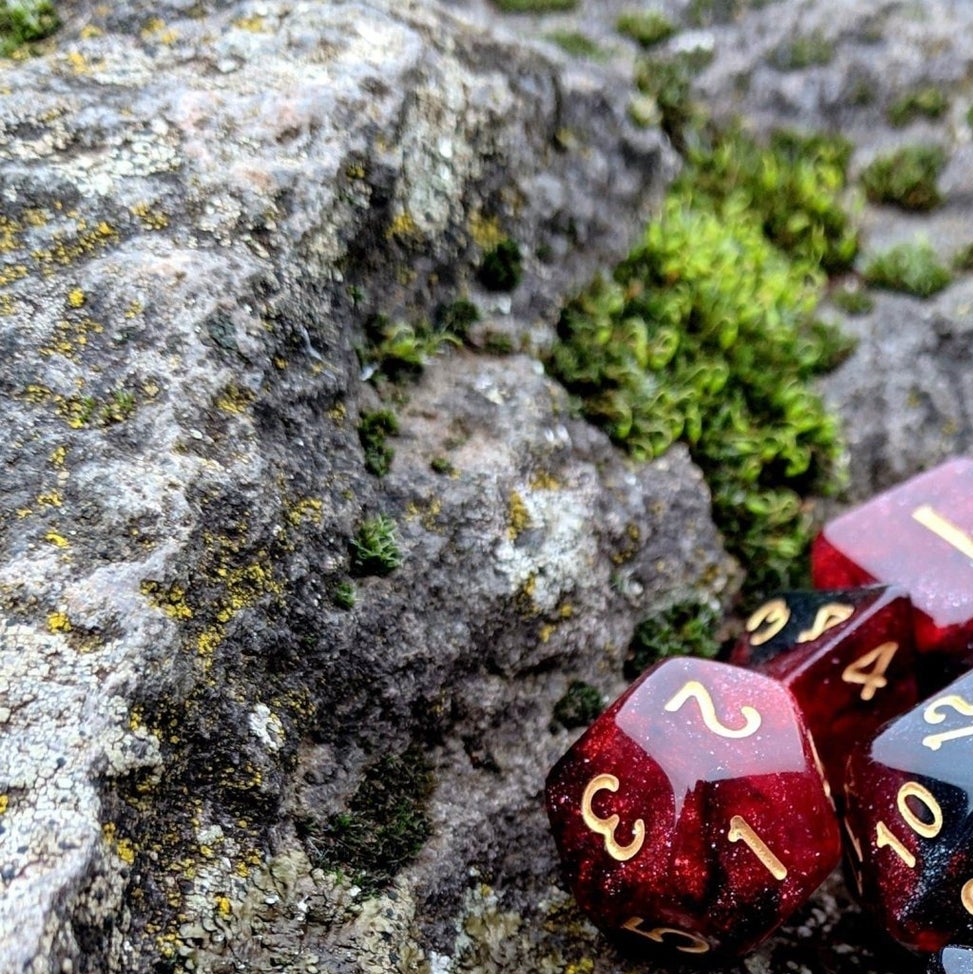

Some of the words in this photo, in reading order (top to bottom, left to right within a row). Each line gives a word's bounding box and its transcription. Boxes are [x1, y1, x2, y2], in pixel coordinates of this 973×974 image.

[842, 641, 898, 700] 4
[665, 681, 761, 738] 2
[582, 773, 645, 861] 3
[728, 815, 787, 880] 1
[876, 781, 943, 868] 10
